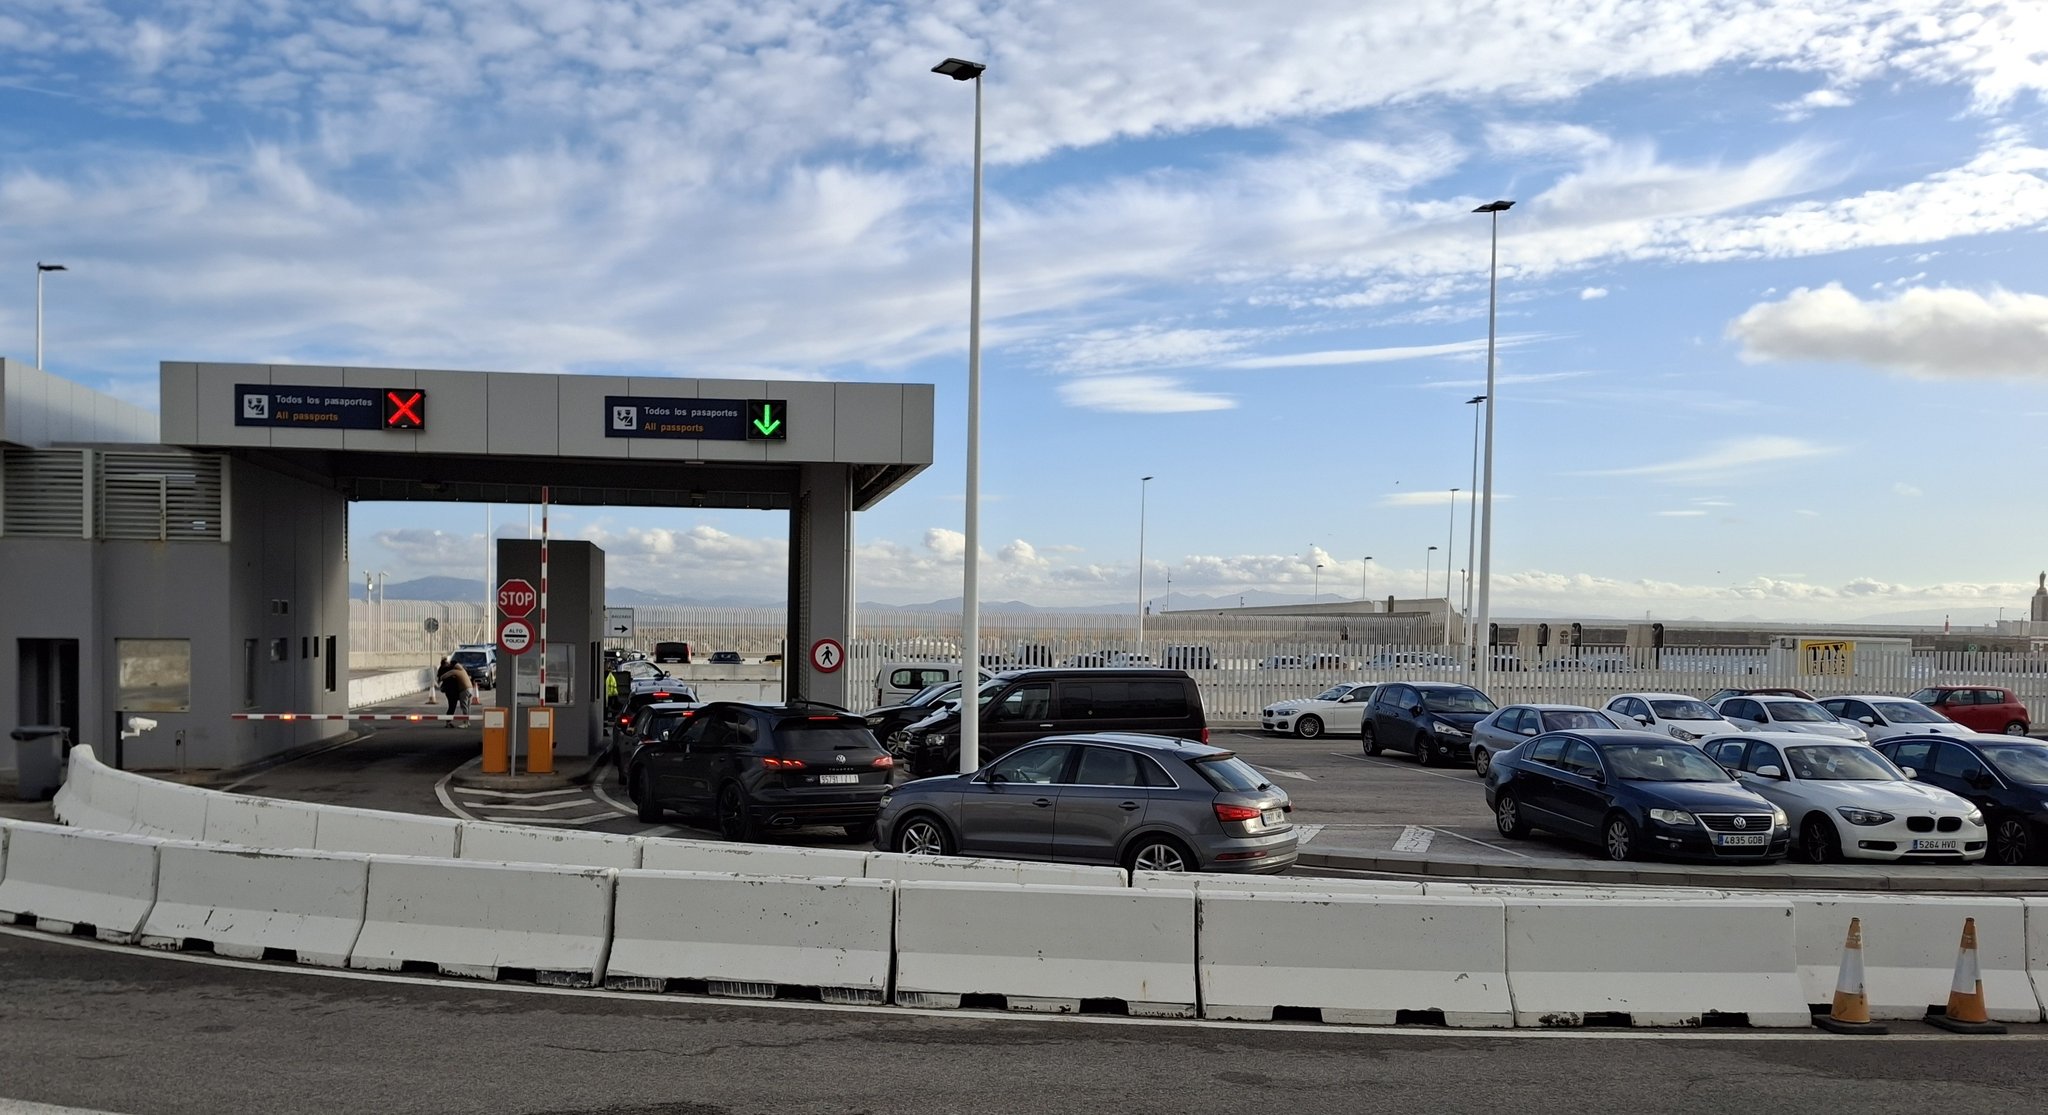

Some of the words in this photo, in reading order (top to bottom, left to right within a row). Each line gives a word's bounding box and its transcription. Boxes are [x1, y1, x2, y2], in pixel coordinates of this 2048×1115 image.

[275, 394, 302, 404] Todos
[307, 395, 320, 405] los
[324, 397, 372, 407] pasaportes
[276, 411, 289, 420] All
[293, 412, 338, 422] passports
[644, 406, 670, 416] Todos
[674, 407, 687, 416] los
[691, 409, 738, 418] pasaportes
[644, 422, 656, 431] All
[660, 424, 704, 433] passports
[500, 591, 533, 606] STOP
[1724, 836, 1746, 845] 4835
[1919, 840, 1939, 849] 5264
